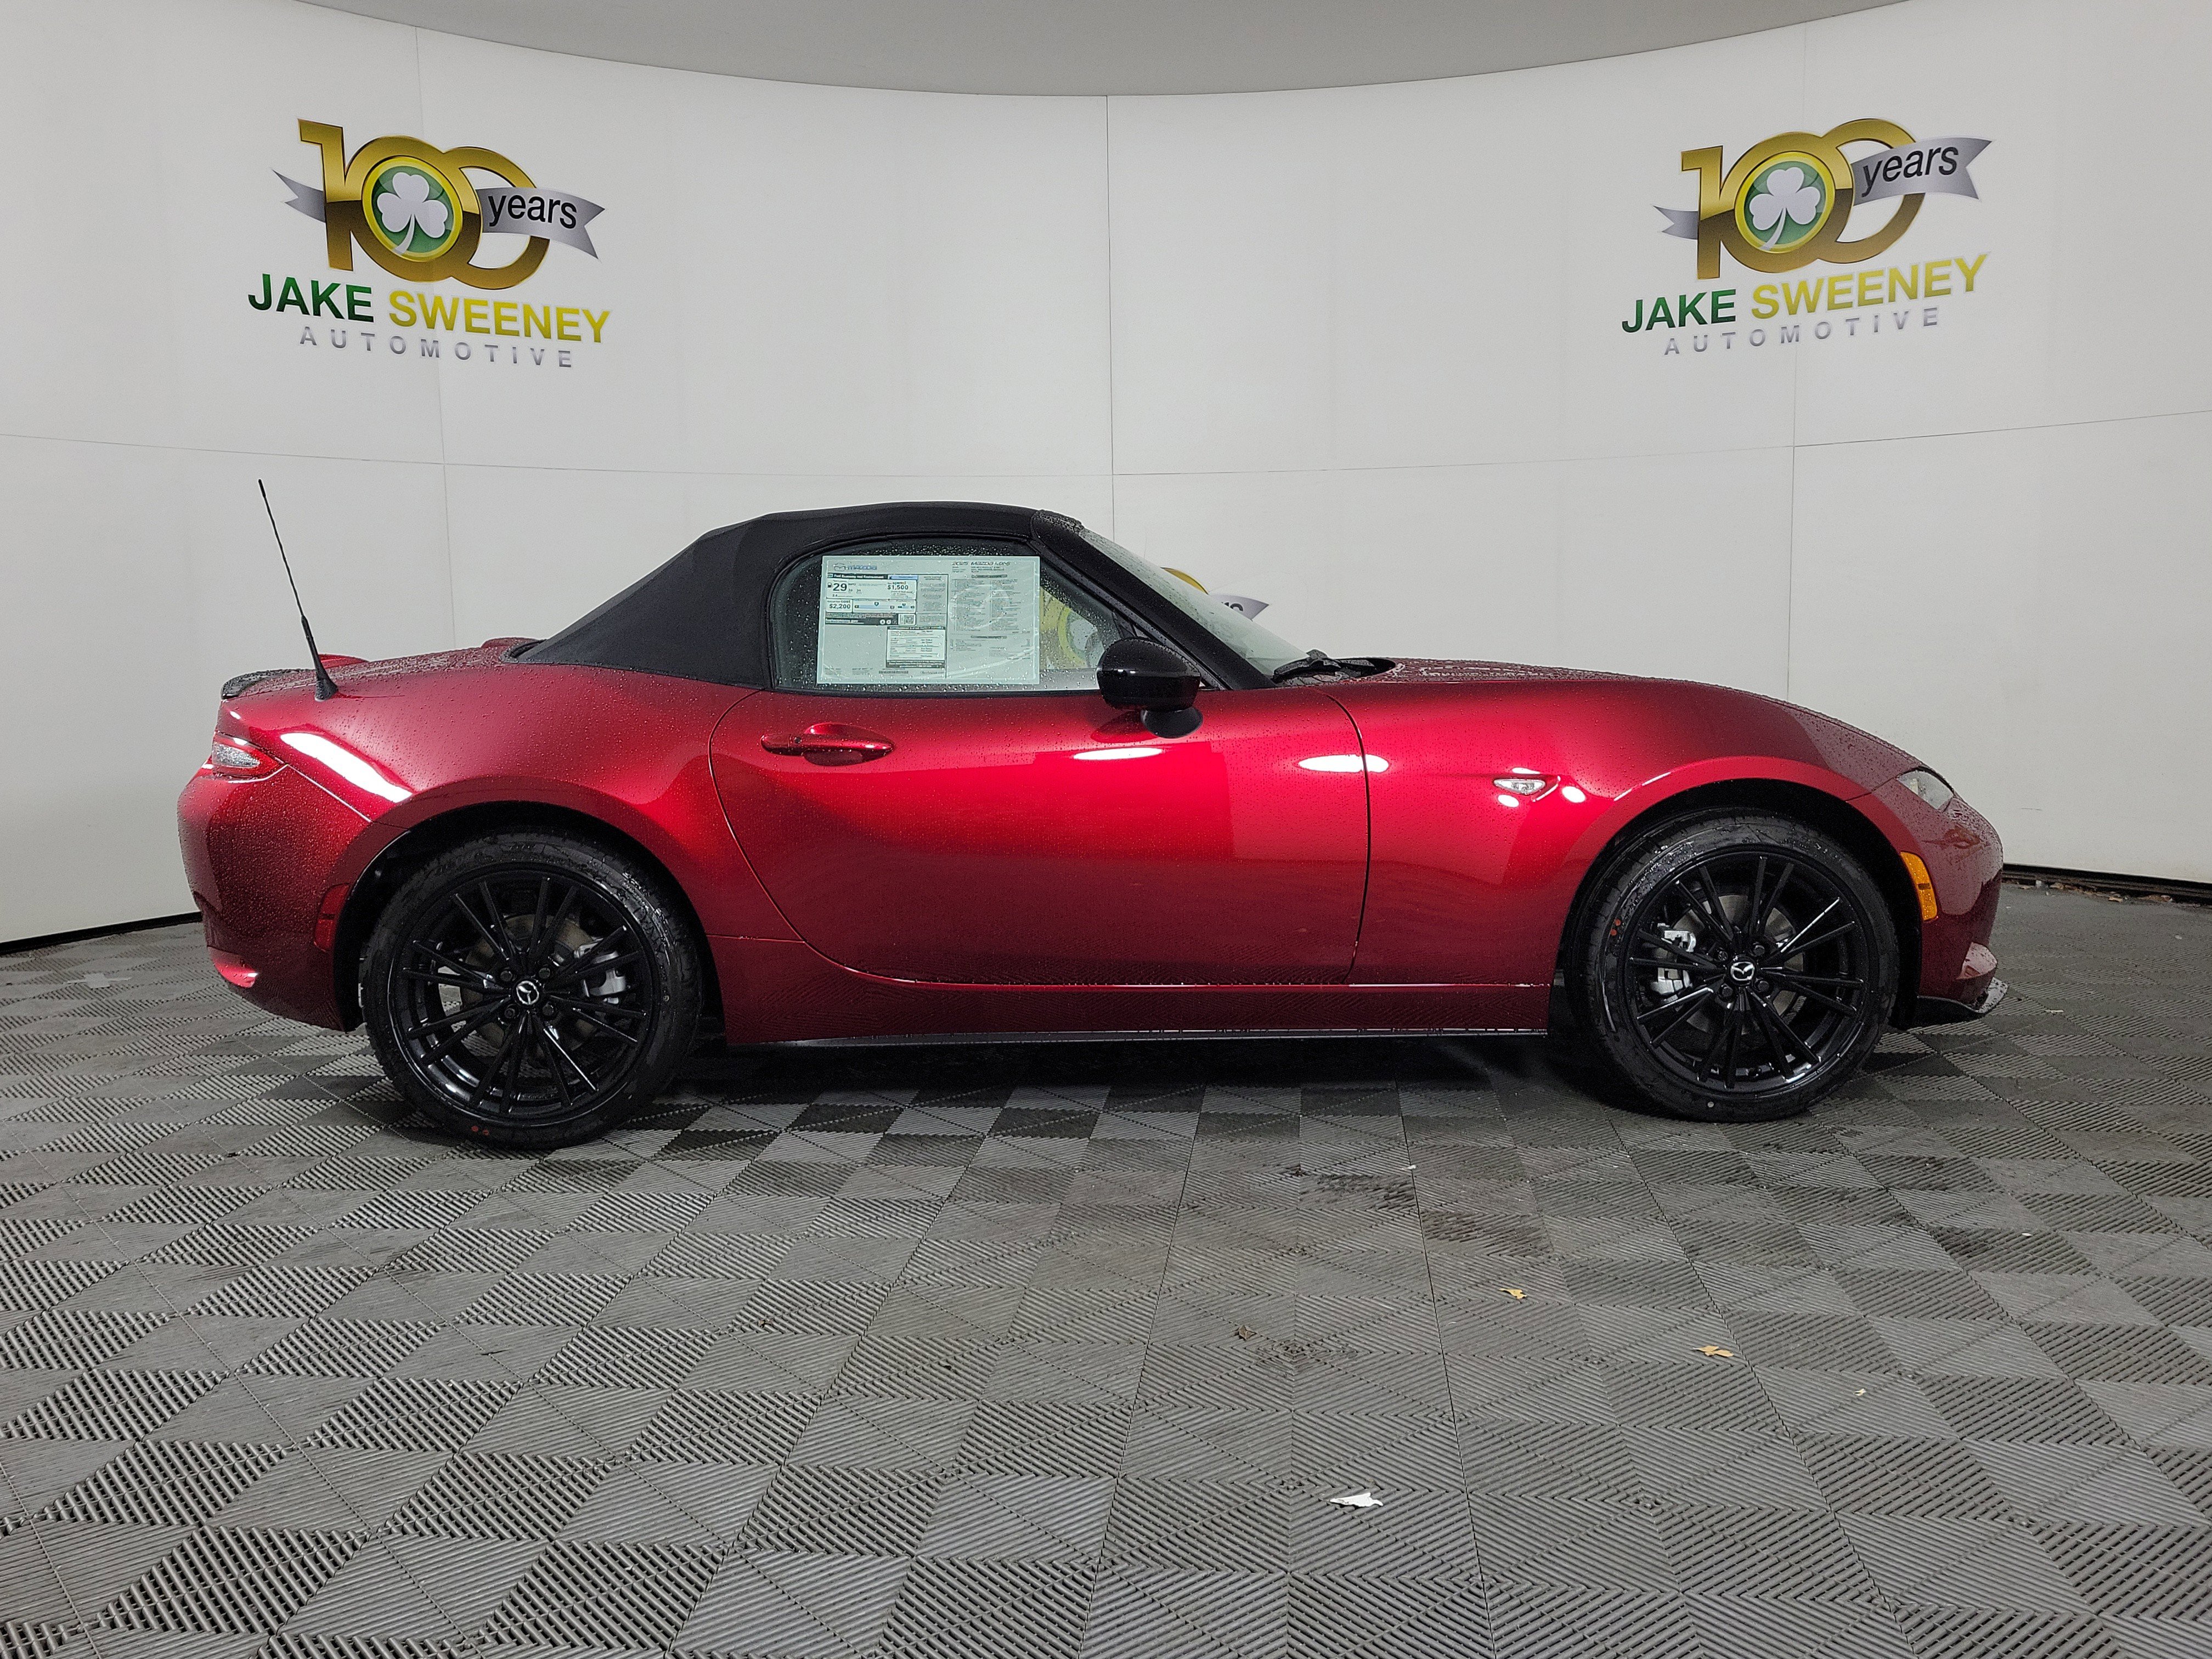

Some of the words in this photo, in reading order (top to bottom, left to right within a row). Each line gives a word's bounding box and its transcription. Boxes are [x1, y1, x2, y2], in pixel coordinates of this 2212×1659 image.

[297, 118, 550, 290] 100
[488, 190, 578, 229] years
[1680, 118, 1926, 280] 100
[1862, 146, 1960, 198] years
[247, 273, 375, 323] JAKE
[389, 290, 611, 343] SWEENEY
[1621, 289, 1737, 333] JAKE
[1752, 253, 1988, 320] SWEENEY
[300, 326, 573, 368] AUTOMOTIVE
[1664, 307, 1939, 356] AUTOMOTIVE
[833, 583, 847, 591] 29
